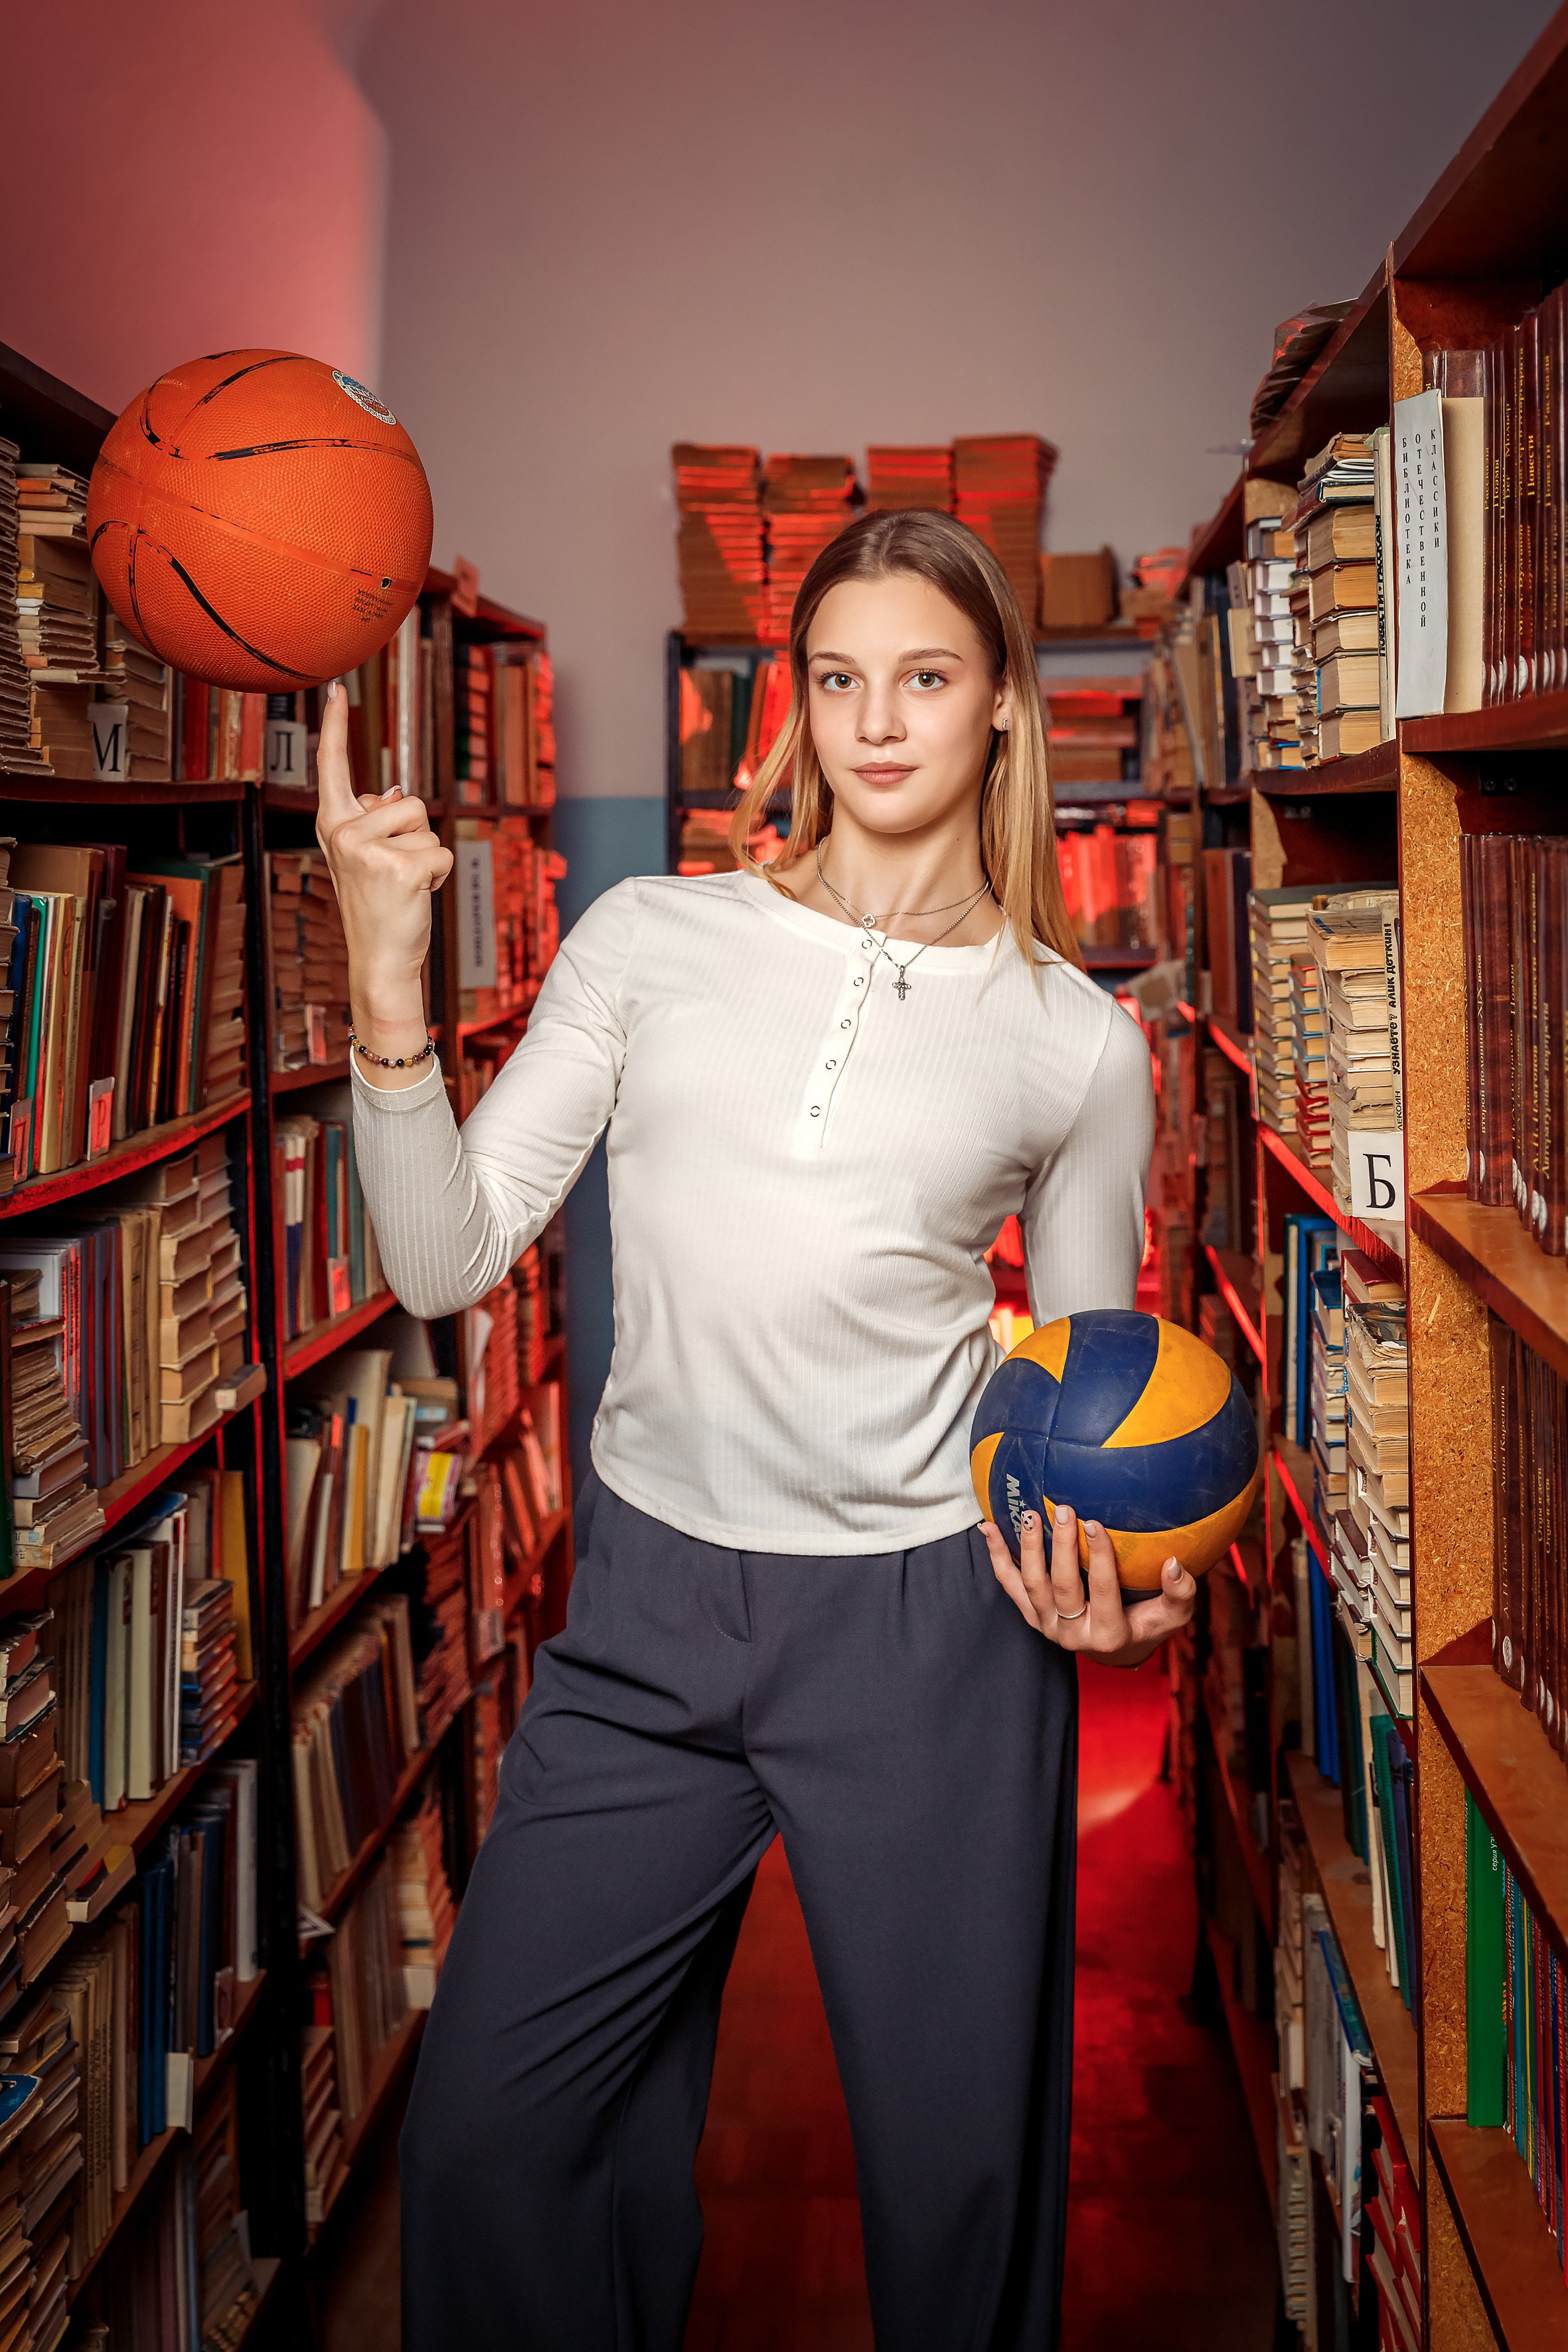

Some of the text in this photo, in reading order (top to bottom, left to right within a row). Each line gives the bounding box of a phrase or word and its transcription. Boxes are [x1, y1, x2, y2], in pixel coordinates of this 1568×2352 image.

[1401, 437, 1411, 586] БИБЛИОТЕКА
[1415, 433, 1427, 627] ОТЕЧЕСТВЕННОЙ
[1430, 428, 1440, 548] КЛАССИКИ
[1375, 514, 1386, 657] ПОВЕСТИ РАССКАЗЫ
[270, 730, 293, 773] Л
[1532, 1152, 1539, 1172] А.
[1541, 1075, 1551, 1180] Литературные
[1362, 1153, 1396, 1209] Б
[1006, 1473, 1026, 1543] MiKA
